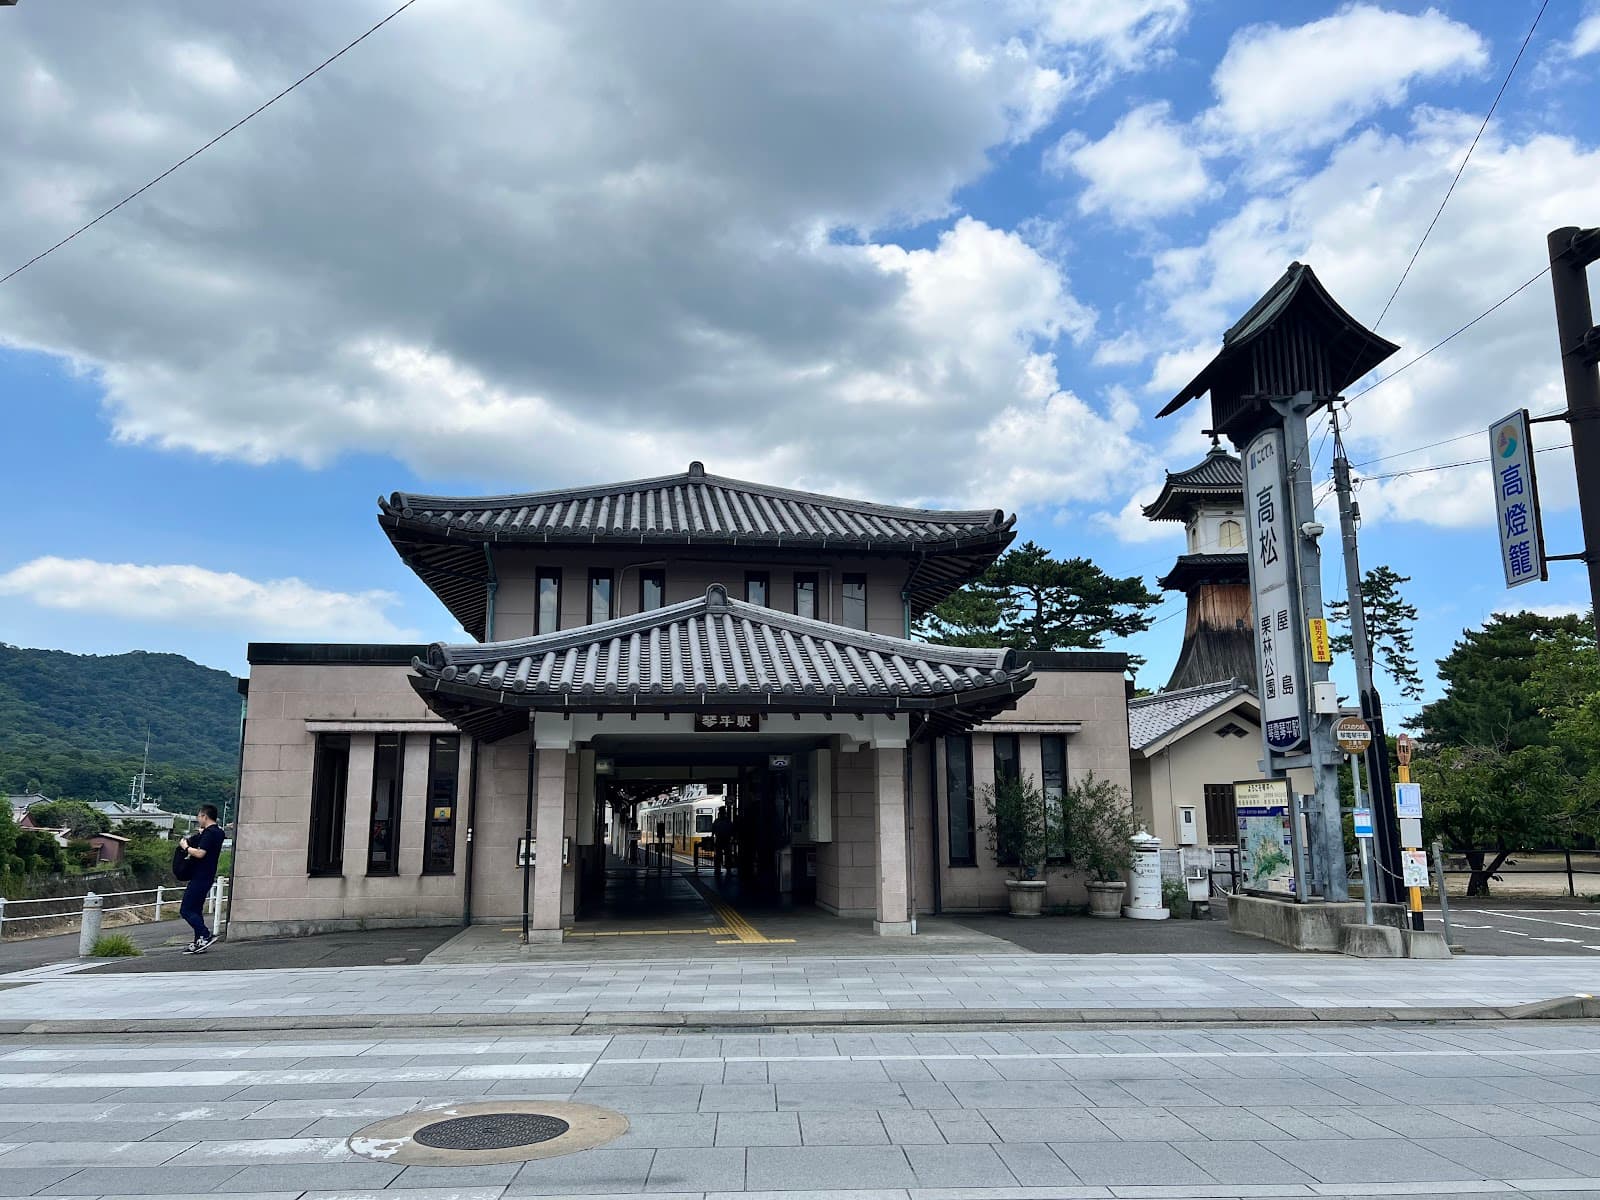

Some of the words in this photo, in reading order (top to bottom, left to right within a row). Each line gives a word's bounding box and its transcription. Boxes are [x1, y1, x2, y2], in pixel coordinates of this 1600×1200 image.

[1256, 484, 1279, 569] 高松
[1500, 464, 1532, 577] 高燈籠
[1261, 615, 1276, 700] 栗林公園
[1277, 609, 1294, 695] 屋島
[702, 715, 751, 727] 琴平駅
